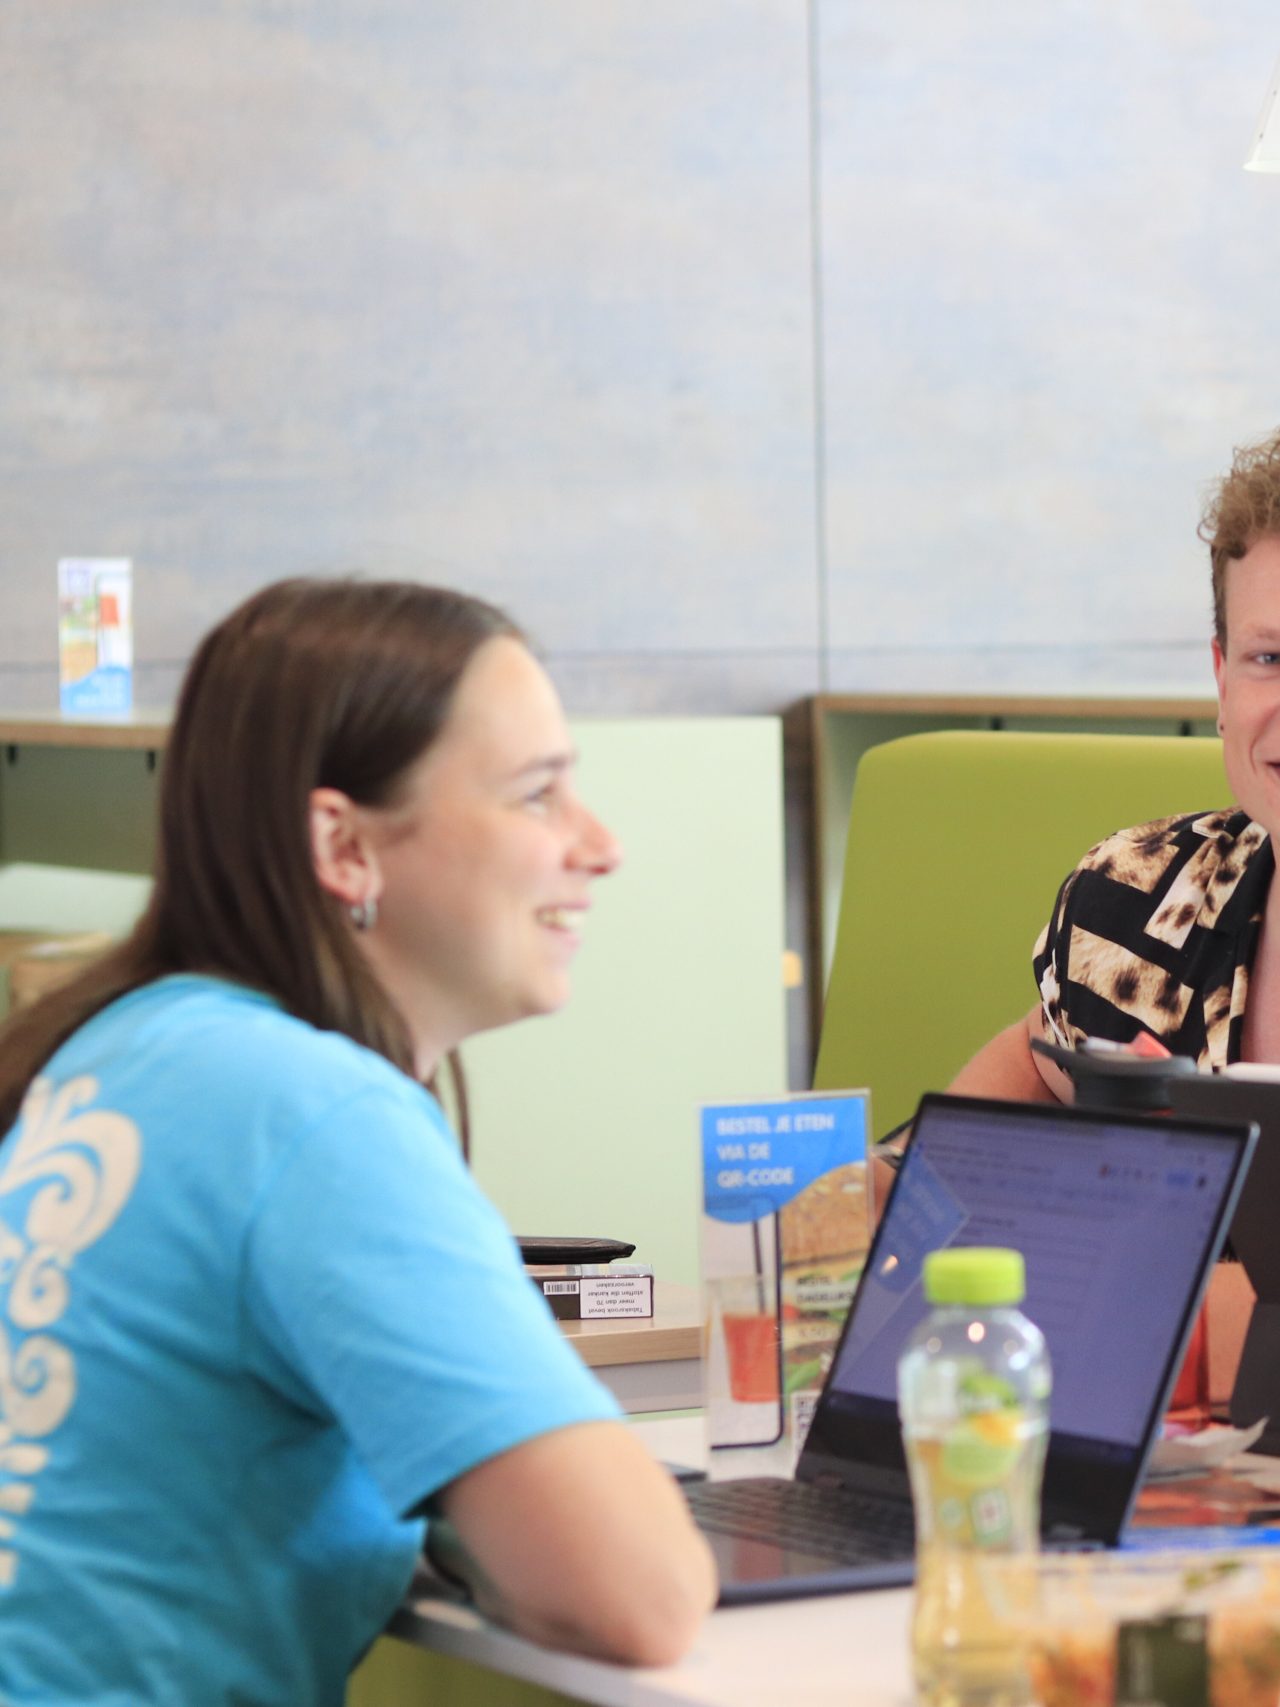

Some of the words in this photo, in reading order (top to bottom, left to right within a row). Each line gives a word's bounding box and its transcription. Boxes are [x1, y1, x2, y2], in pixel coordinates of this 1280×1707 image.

[716, 1116, 770, 1136] BESTEL
[775, 1115, 791, 1133] JE
[794, 1113, 835, 1132] ETEN
[716, 1144, 744, 1161] VIA
[747, 1142, 770, 1160] DE
[717, 1167, 794, 1188] QR-CODE
